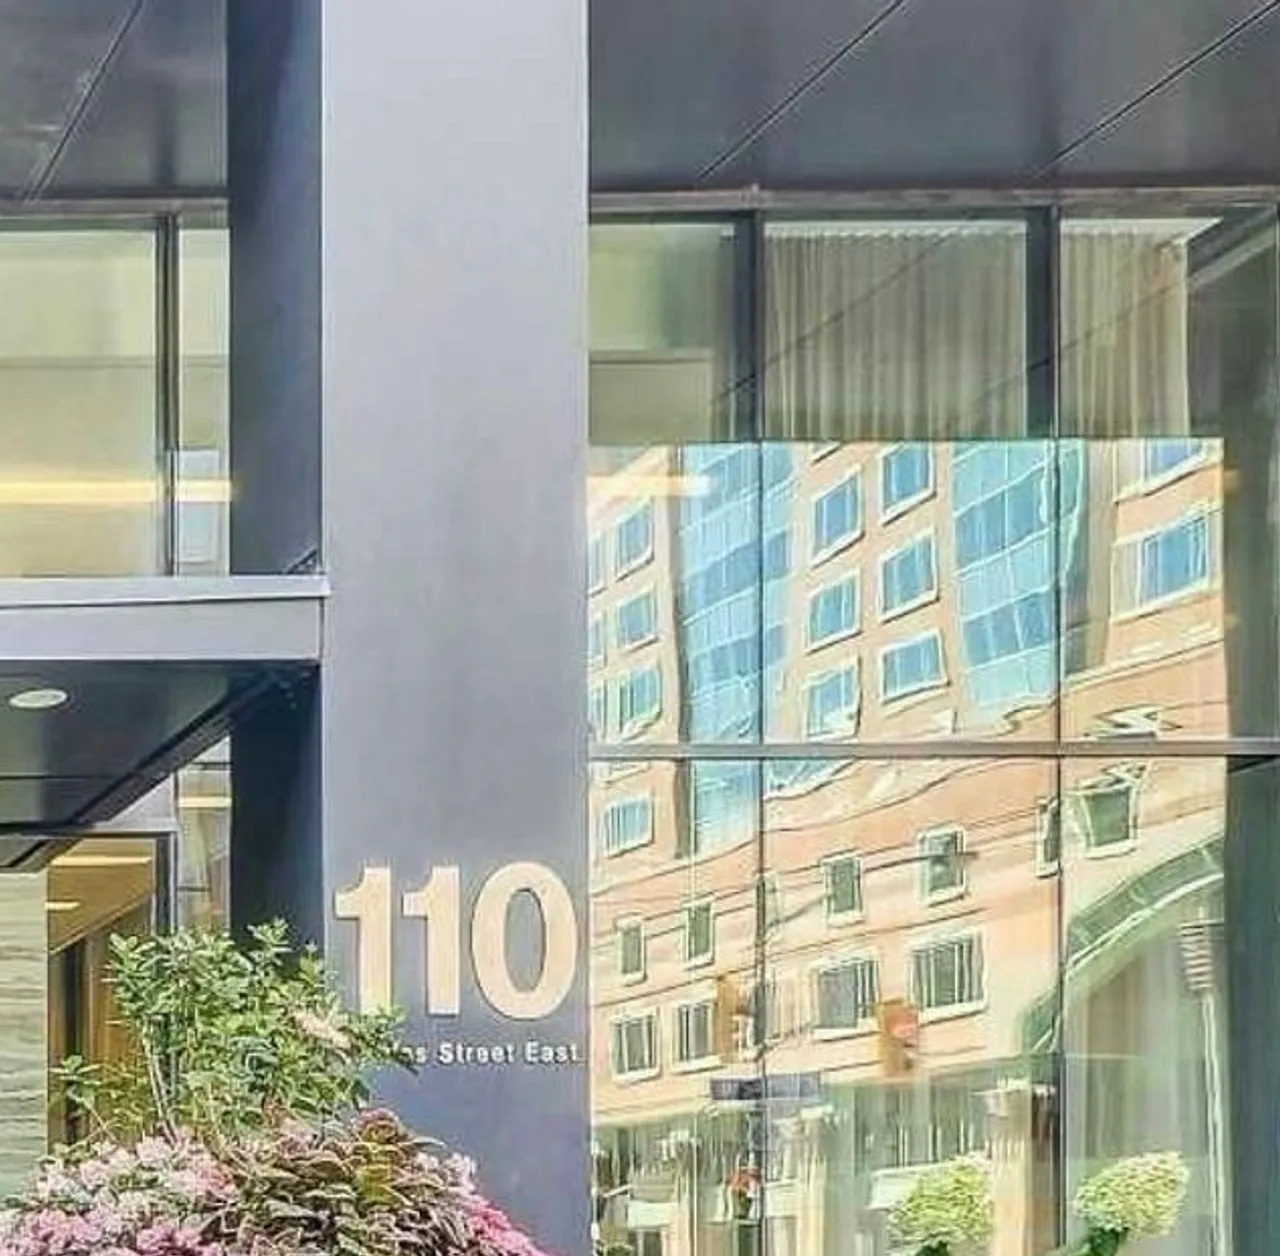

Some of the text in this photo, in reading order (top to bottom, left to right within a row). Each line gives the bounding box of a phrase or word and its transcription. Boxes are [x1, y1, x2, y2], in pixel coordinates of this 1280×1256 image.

[334, 861, 578, 1019] 110
[439, 1041, 514, 1065] Street
[524, 1041, 578, 1064] East
